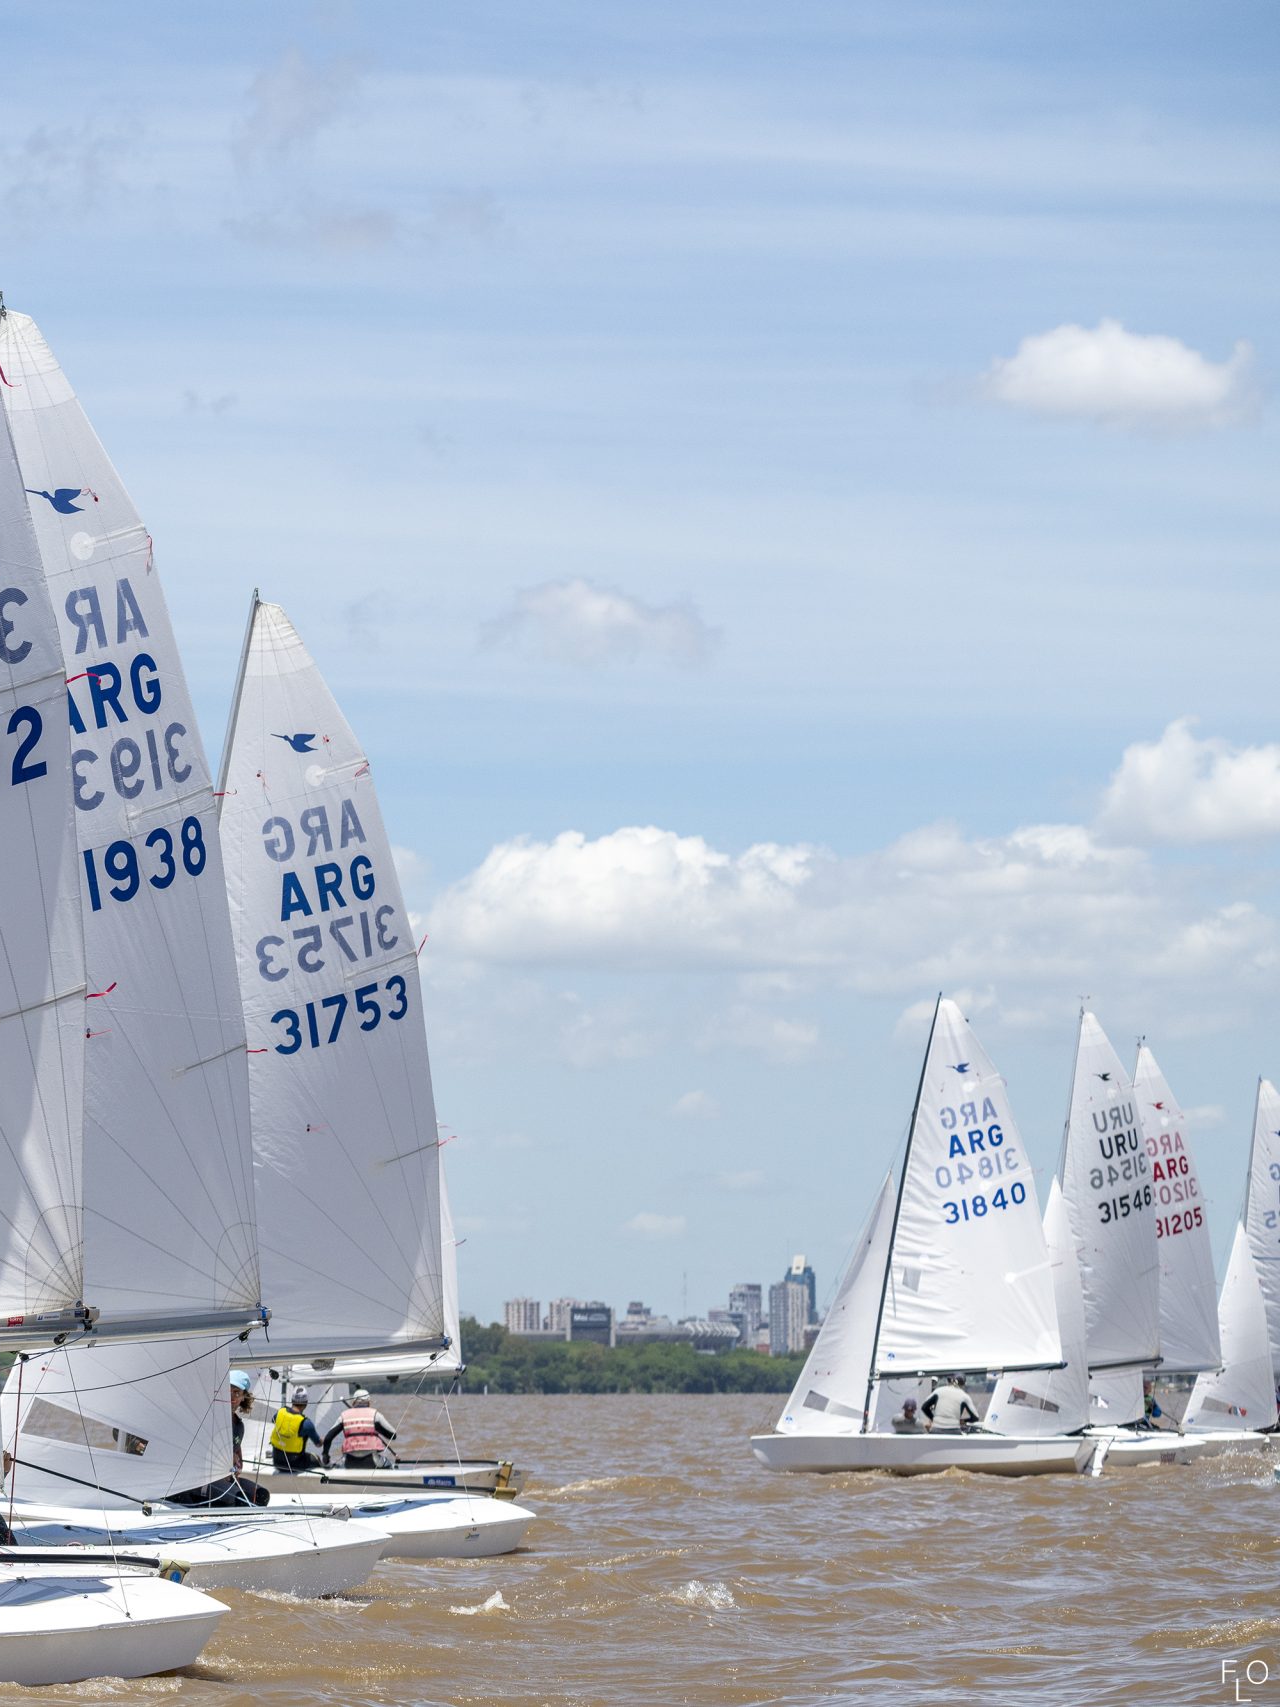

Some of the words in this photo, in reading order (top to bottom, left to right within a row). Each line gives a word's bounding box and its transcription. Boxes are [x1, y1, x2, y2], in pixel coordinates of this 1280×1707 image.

[82, 815, 206, 912] 1938
[281, 854, 376, 922] ARG
[270, 975, 408, 1055] 31753
[949, 1124, 1004, 1158] ARG
[1099, 1128, 1138, 1159] URU
[1153, 1155, 1189, 1182] ARG
[943, 1182, 1026, 1224] 31840
[1098, 1185, 1151, 1224] 31546
[1156, 1207, 1203, 1239] 31205
